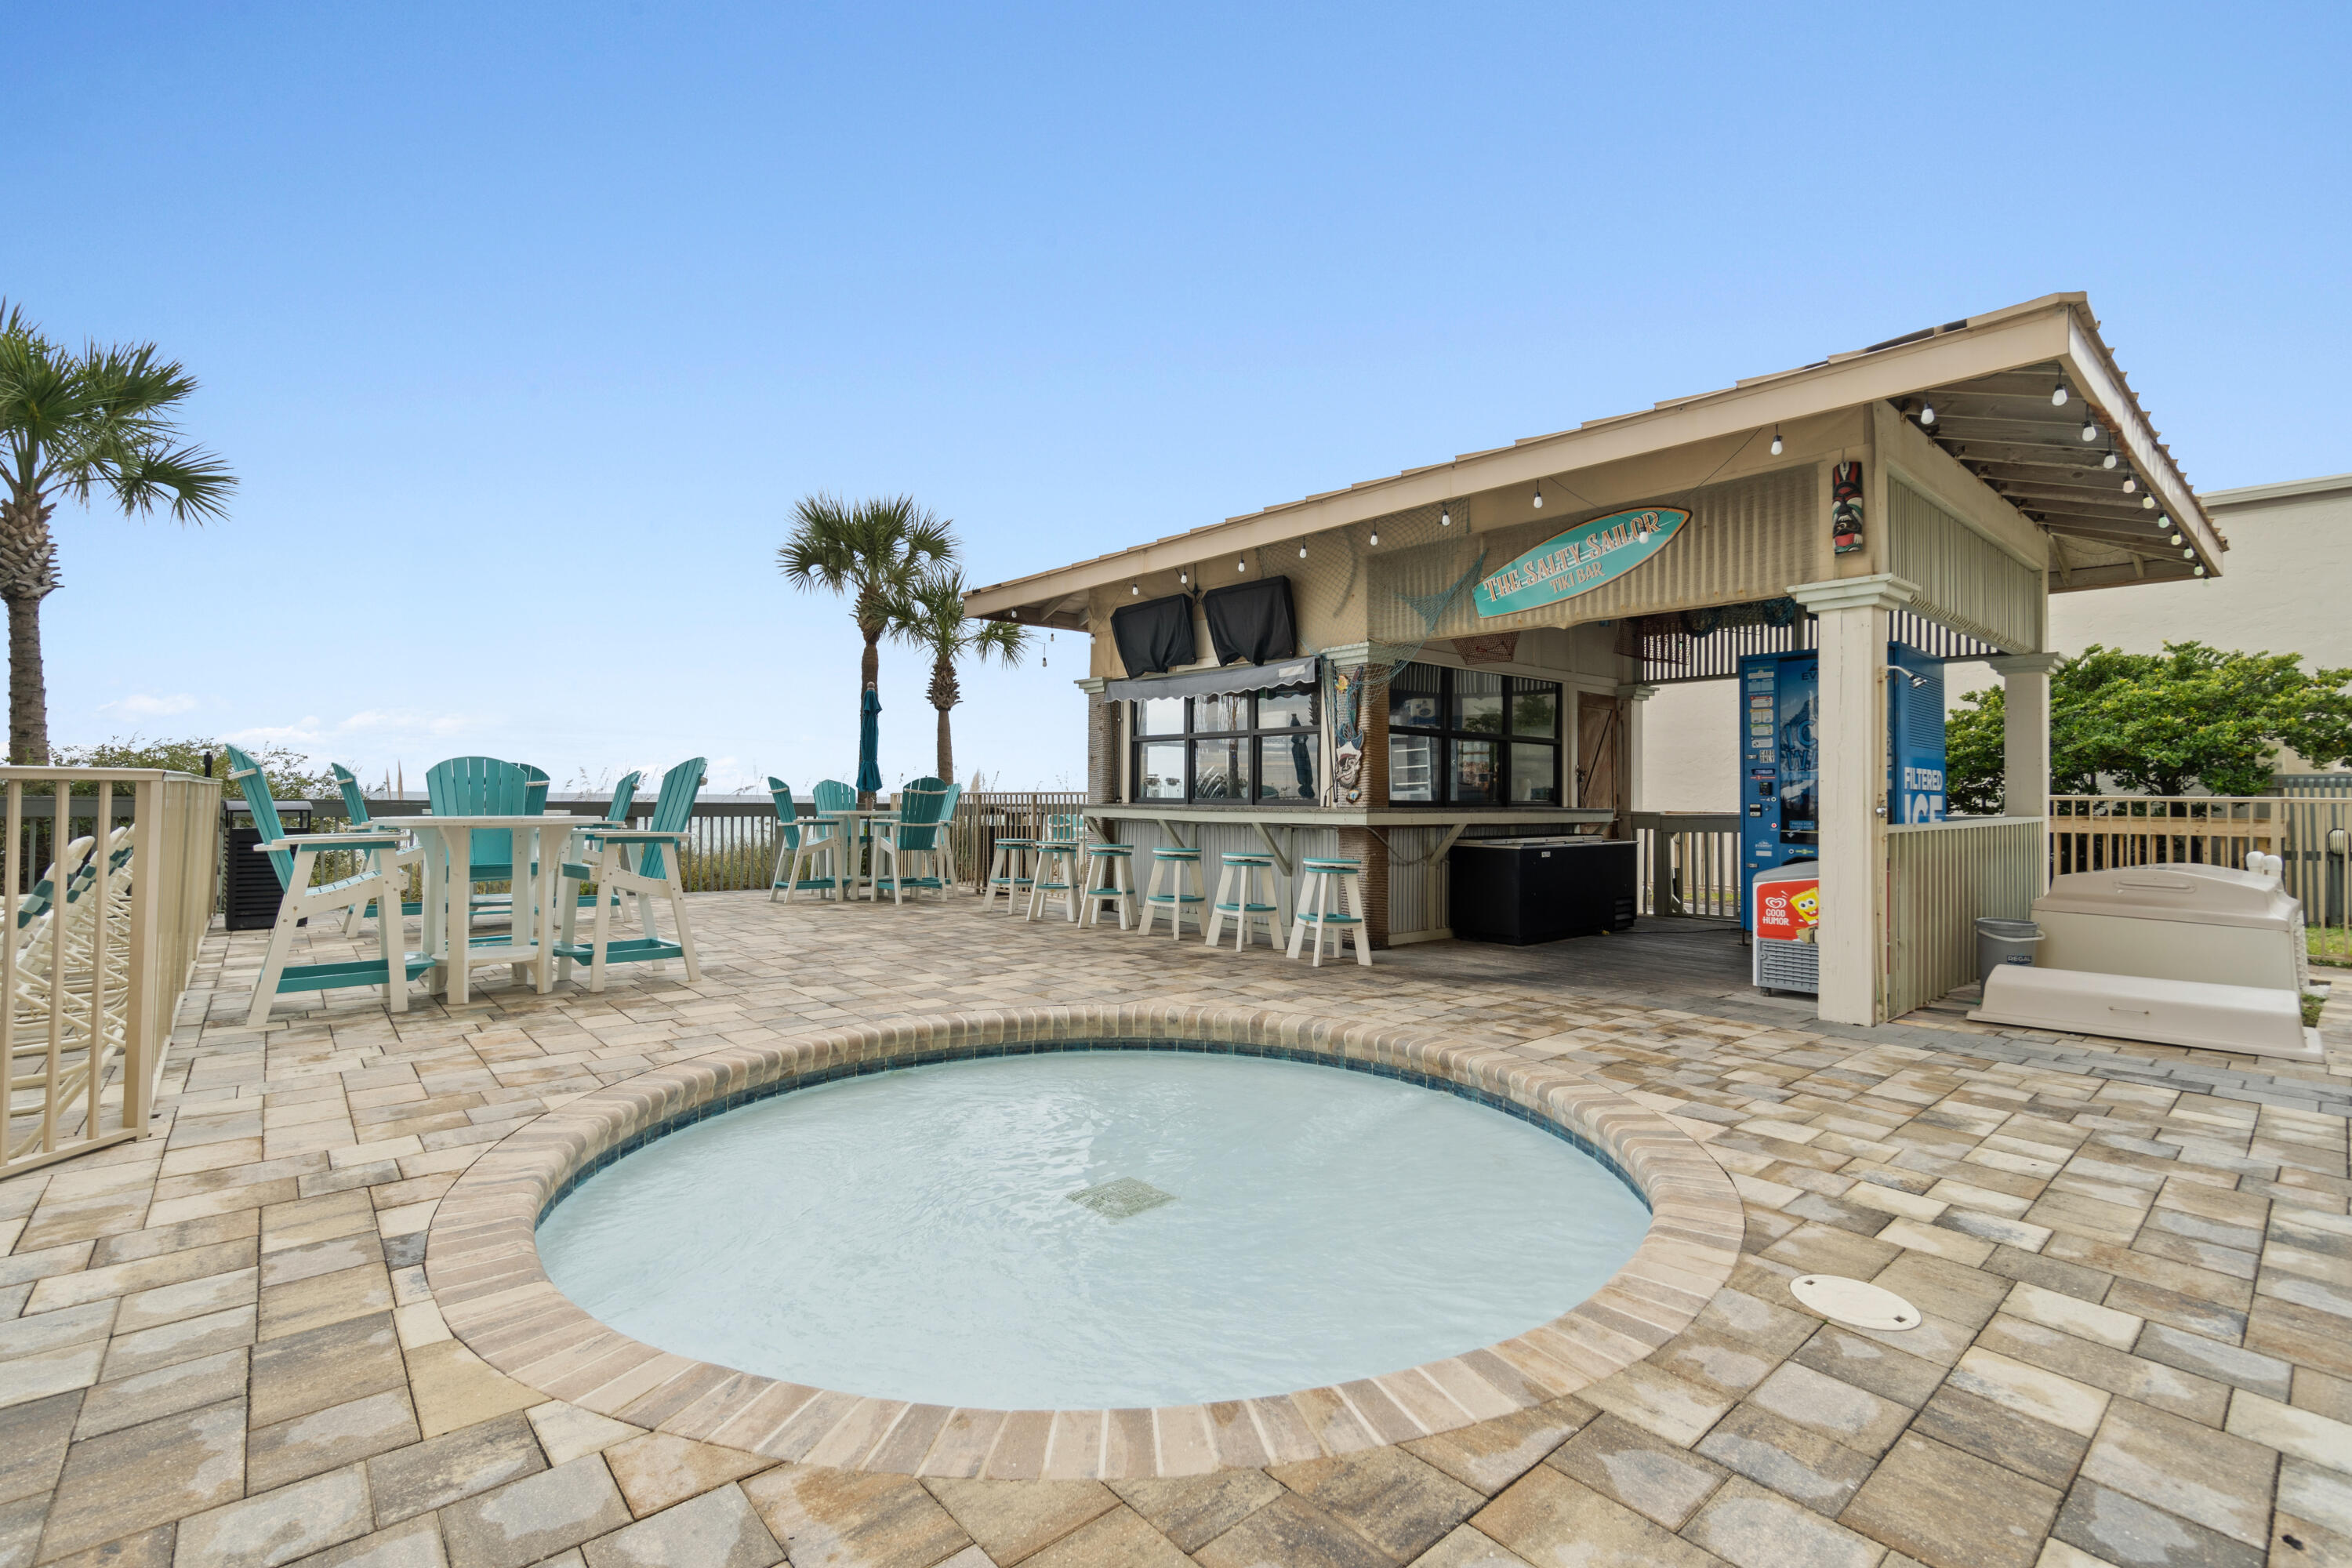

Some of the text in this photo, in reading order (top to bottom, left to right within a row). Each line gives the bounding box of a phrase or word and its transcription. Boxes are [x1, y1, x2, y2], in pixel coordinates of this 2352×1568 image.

[1483, 511, 1661, 602] THE SALTY SAILOR
[1549, 561, 1606, 593] TIKI BAR
[1785, 719, 1818, 749] IC
[1904, 767, 1943, 791] FILTERED
[1762, 916, 1790, 926] HUMOR
[1766, 909, 1786, 917] GOOD
